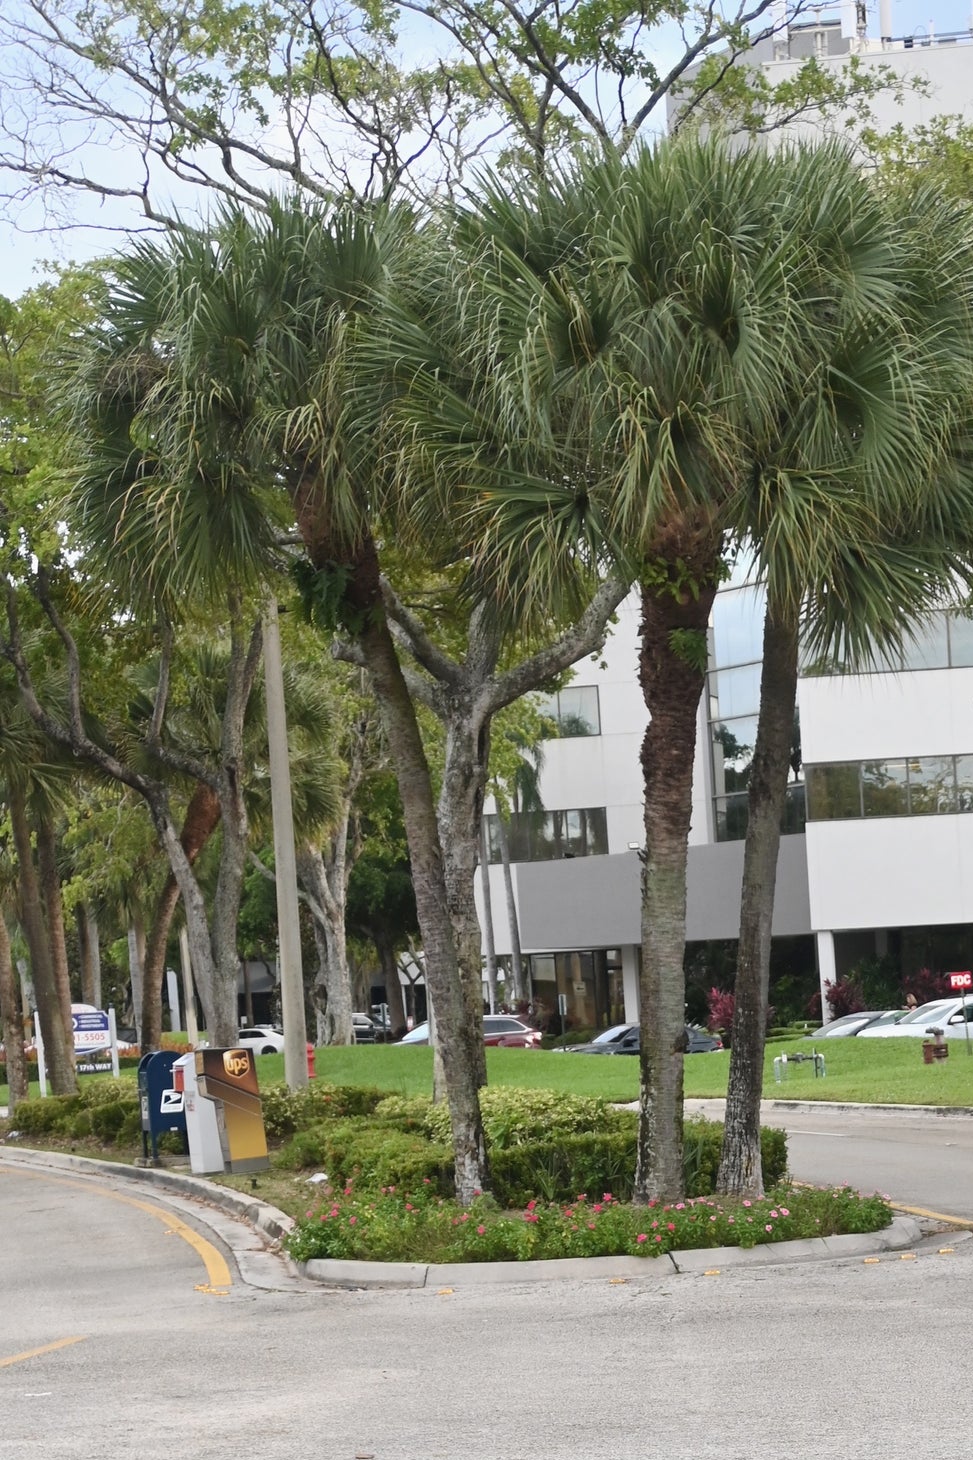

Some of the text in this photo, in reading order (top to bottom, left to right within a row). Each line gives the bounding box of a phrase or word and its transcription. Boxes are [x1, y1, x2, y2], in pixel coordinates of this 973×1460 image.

[950, 974, 972, 986] FDC
[74, 1032, 105, 1041] 1-5505
[226, 1056, 249, 1075] ups
